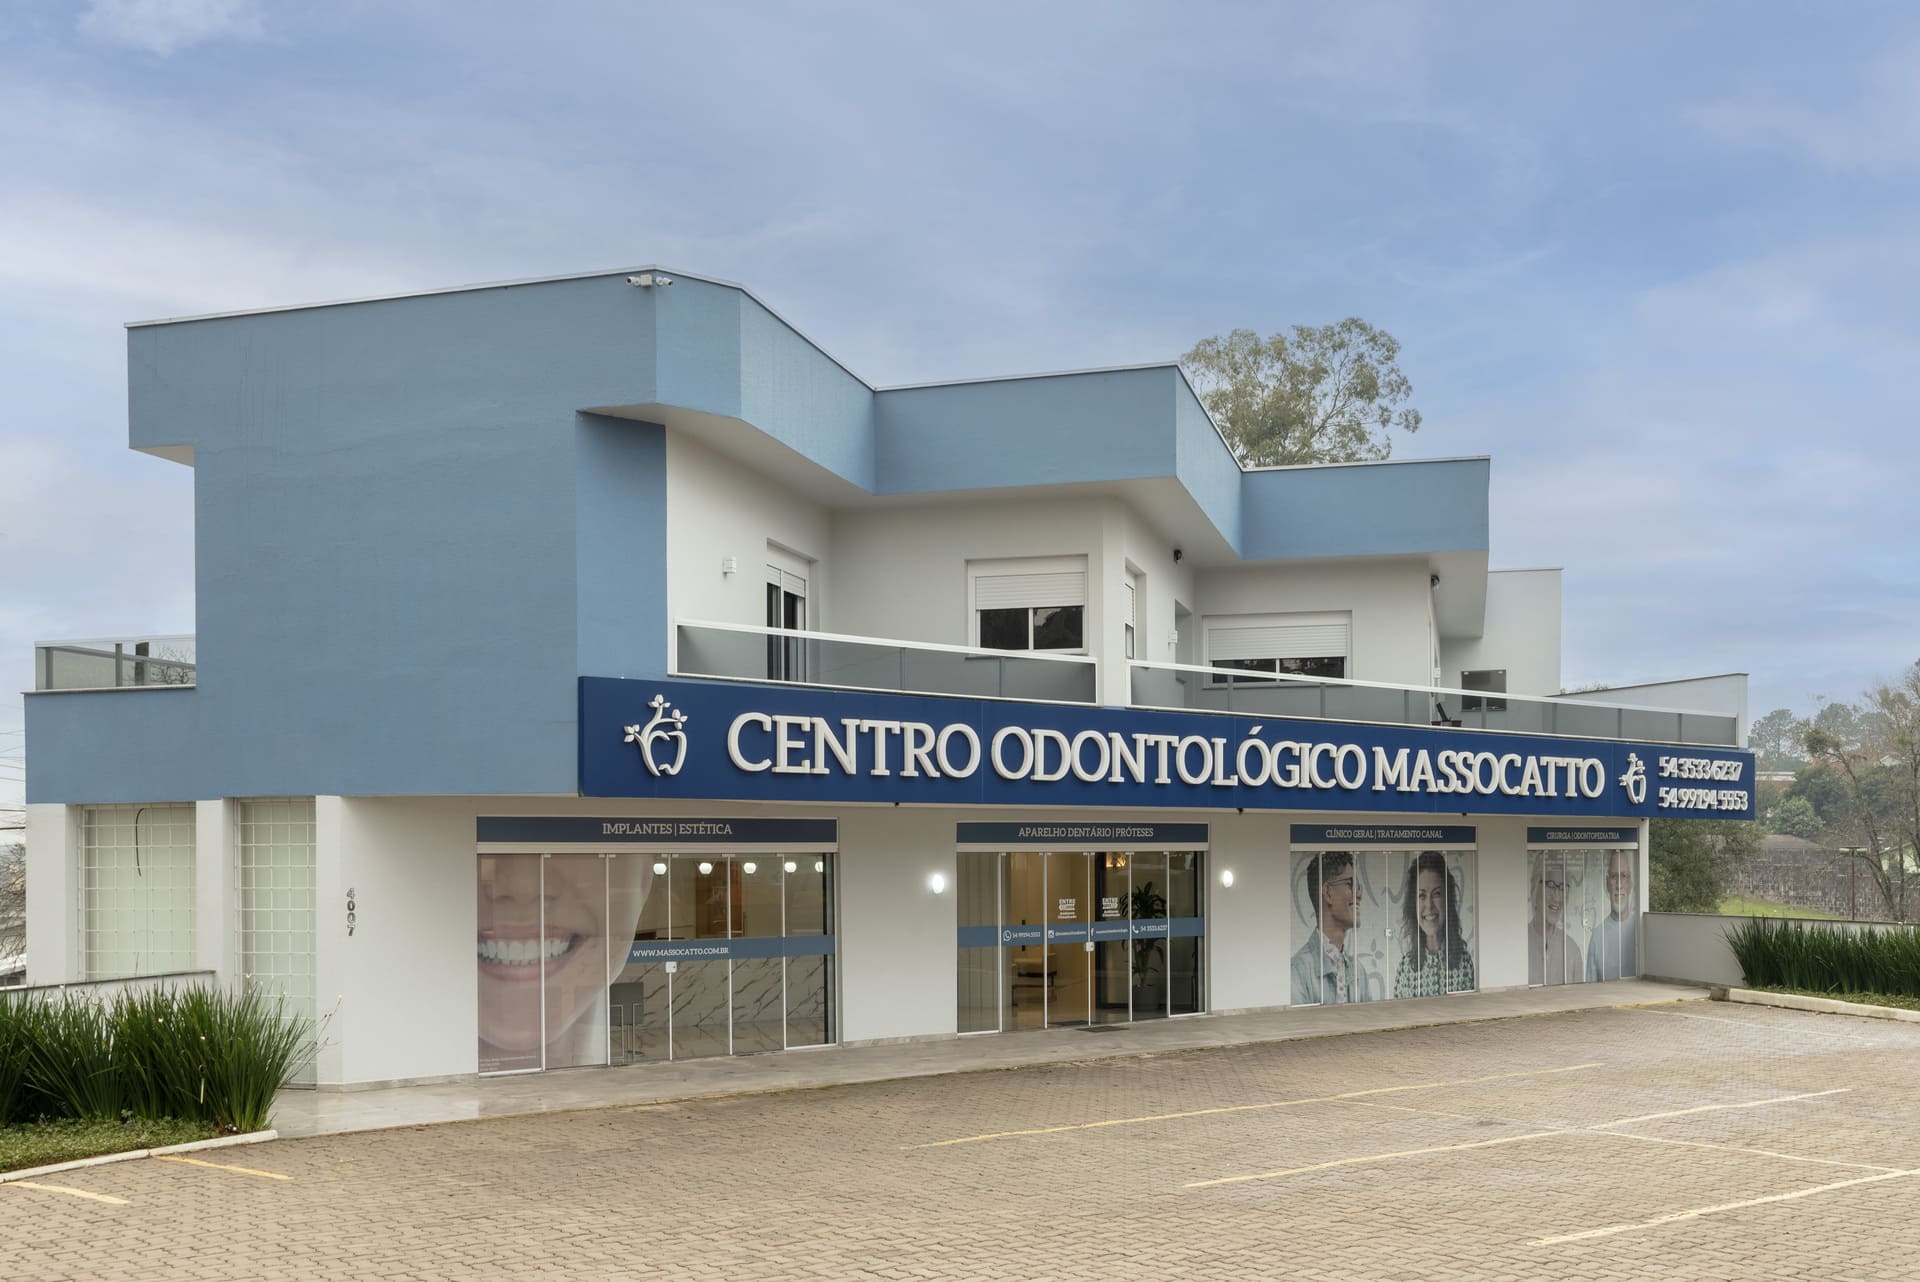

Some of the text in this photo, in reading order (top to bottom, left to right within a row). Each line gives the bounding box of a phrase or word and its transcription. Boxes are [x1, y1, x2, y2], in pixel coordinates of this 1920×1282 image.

[728, 711, 1606, 798] CENTRO ODONTOLÓGICO MASSOCATTO
[602, 821, 733, 835] IMPLANTES ESTÉTICA
[1018, 825, 1154, 838] APARELHO DENTÁRIO PRÓTESES
[1325, 828, 1443, 839] CLÍNICO GERAL TRATAMENTO CANAL
[346, 887, 356, 937] 4007
[632, 946, 729, 958] WWW.MASSOCATTO.COM.BR
